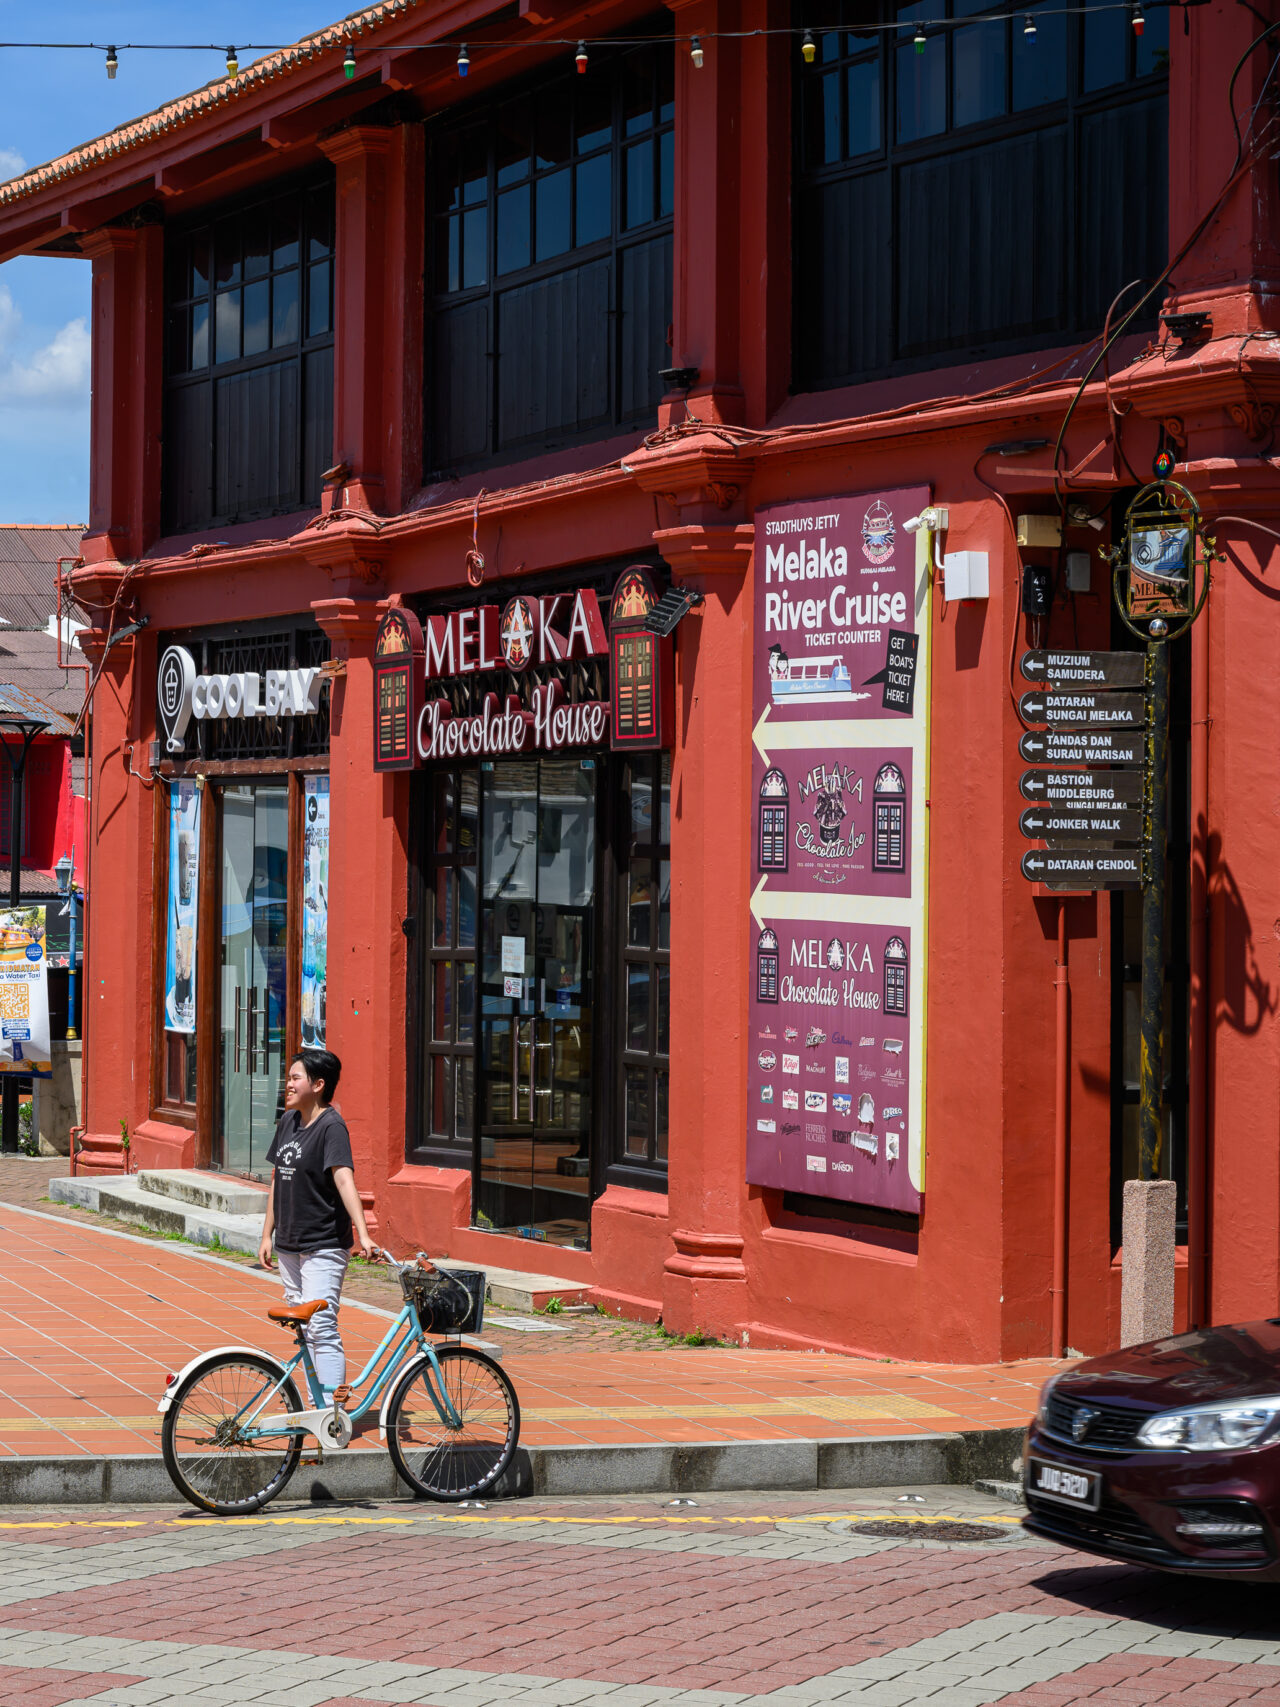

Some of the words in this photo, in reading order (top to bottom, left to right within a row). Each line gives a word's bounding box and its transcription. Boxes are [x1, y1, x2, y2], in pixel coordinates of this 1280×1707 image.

[766, 517, 814, 536] STADTHUYS
[815, 514, 840, 531] JETTY
[765, 537, 848, 584] Melaka
[765, 589, 827, 632] River
[829, 581, 907, 628] Cruise
[424, 589, 598, 679] MELAKA
[804, 632, 836, 647] TICKET
[837, 630, 881, 645] COUNTER
[891, 637, 905, 651] GET
[889, 654, 914, 670] BOAT'S
[1047, 655, 1091, 666] MUZIUM
[888, 671, 912, 687] TICKET
[1047, 669, 1106, 681] SAMUDERA
[886, 689, 905, 702] HERE
[1046, 696, 1095, 707] DATARAN
[417, 692, 527, 760] Chocolate
[532, 678, 607, 750] House
[1046, 710, 1087, 721] SUNGAI
[1089, 711, 1133, 721] MELAKA
[1046, 735, 1088, 746] TANDAS
[1090, 736, 1112, 747] DAN
[1046, 749, 1083, 759] SURAU
[1085, 749, 1133, 760] WARISAN
[798, 761, 864, 804] MELAKA
[1047, 774, 1093, 786] BASTION
[1047, 788, 1115, 799] MIDDLEBURG
[1066, 801, 1095, 809] SUNGAI
[1096, 801, 1128, 810] MELAKA
[1046, 818, 1089, 830] JONKER
[1090, 819, 1121, 830] WALK
[795, 822, 847, 859] Chocolate
[847, 820, 867, 857] Ice
[1047, 859, 1094, 870] DATARAN
[1096, 859, 1138, 871] CENDOL
[789, 938, 875, 974] MELAKA
[780, 975, 840, 1007] Chocolate
[842, 977, 882, 1011] House
[806, 1123, 826, 1134] FERRERO
[806, 1133, 827, 1144] ROCHER
[832, 1162, 854, 1173] DANSON
